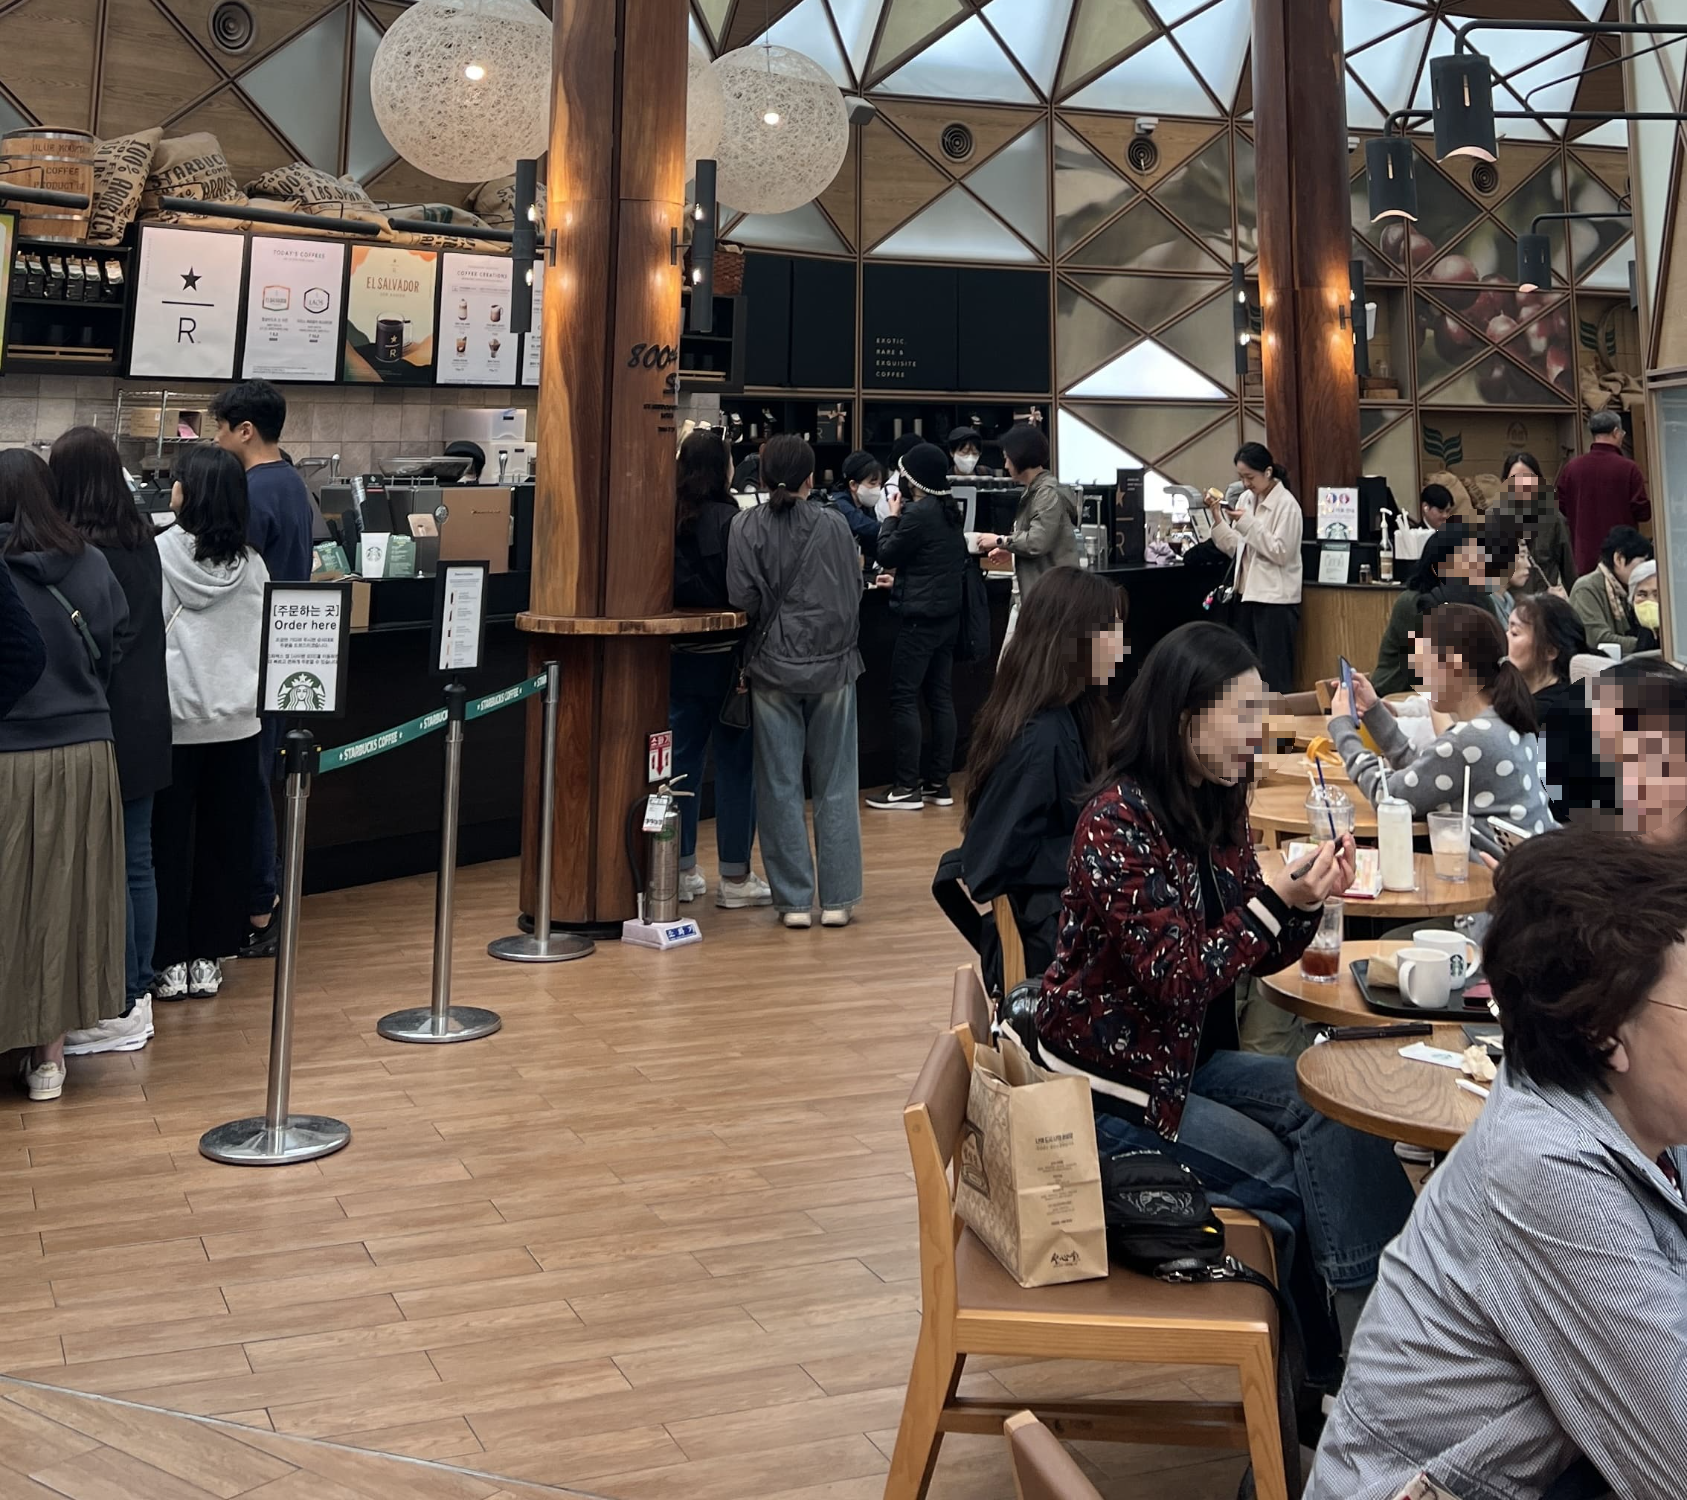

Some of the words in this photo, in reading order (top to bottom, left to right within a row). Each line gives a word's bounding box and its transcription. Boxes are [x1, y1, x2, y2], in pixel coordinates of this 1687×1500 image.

[118, 140, 151, 174] 100%
[46, 167, 79, 176] COFFEE
[89, 178, 133, 240] ARABICA
[273, 249, 298, 257] TODAY'S
[366, 276, 376, 289] EL
[377, 278, 420, 293] SALVADOR
[178, 317, 196, 343] R
[273, 605, 321, 617] [주문하는
[325, 605, 339, 617] 곳]
[274, 620, 307, 630] Order
[311, 620, 337, 630] here
[344, 742, 378, 761] STARBUCKS
[378, 731, 398, 749] COFFEE
